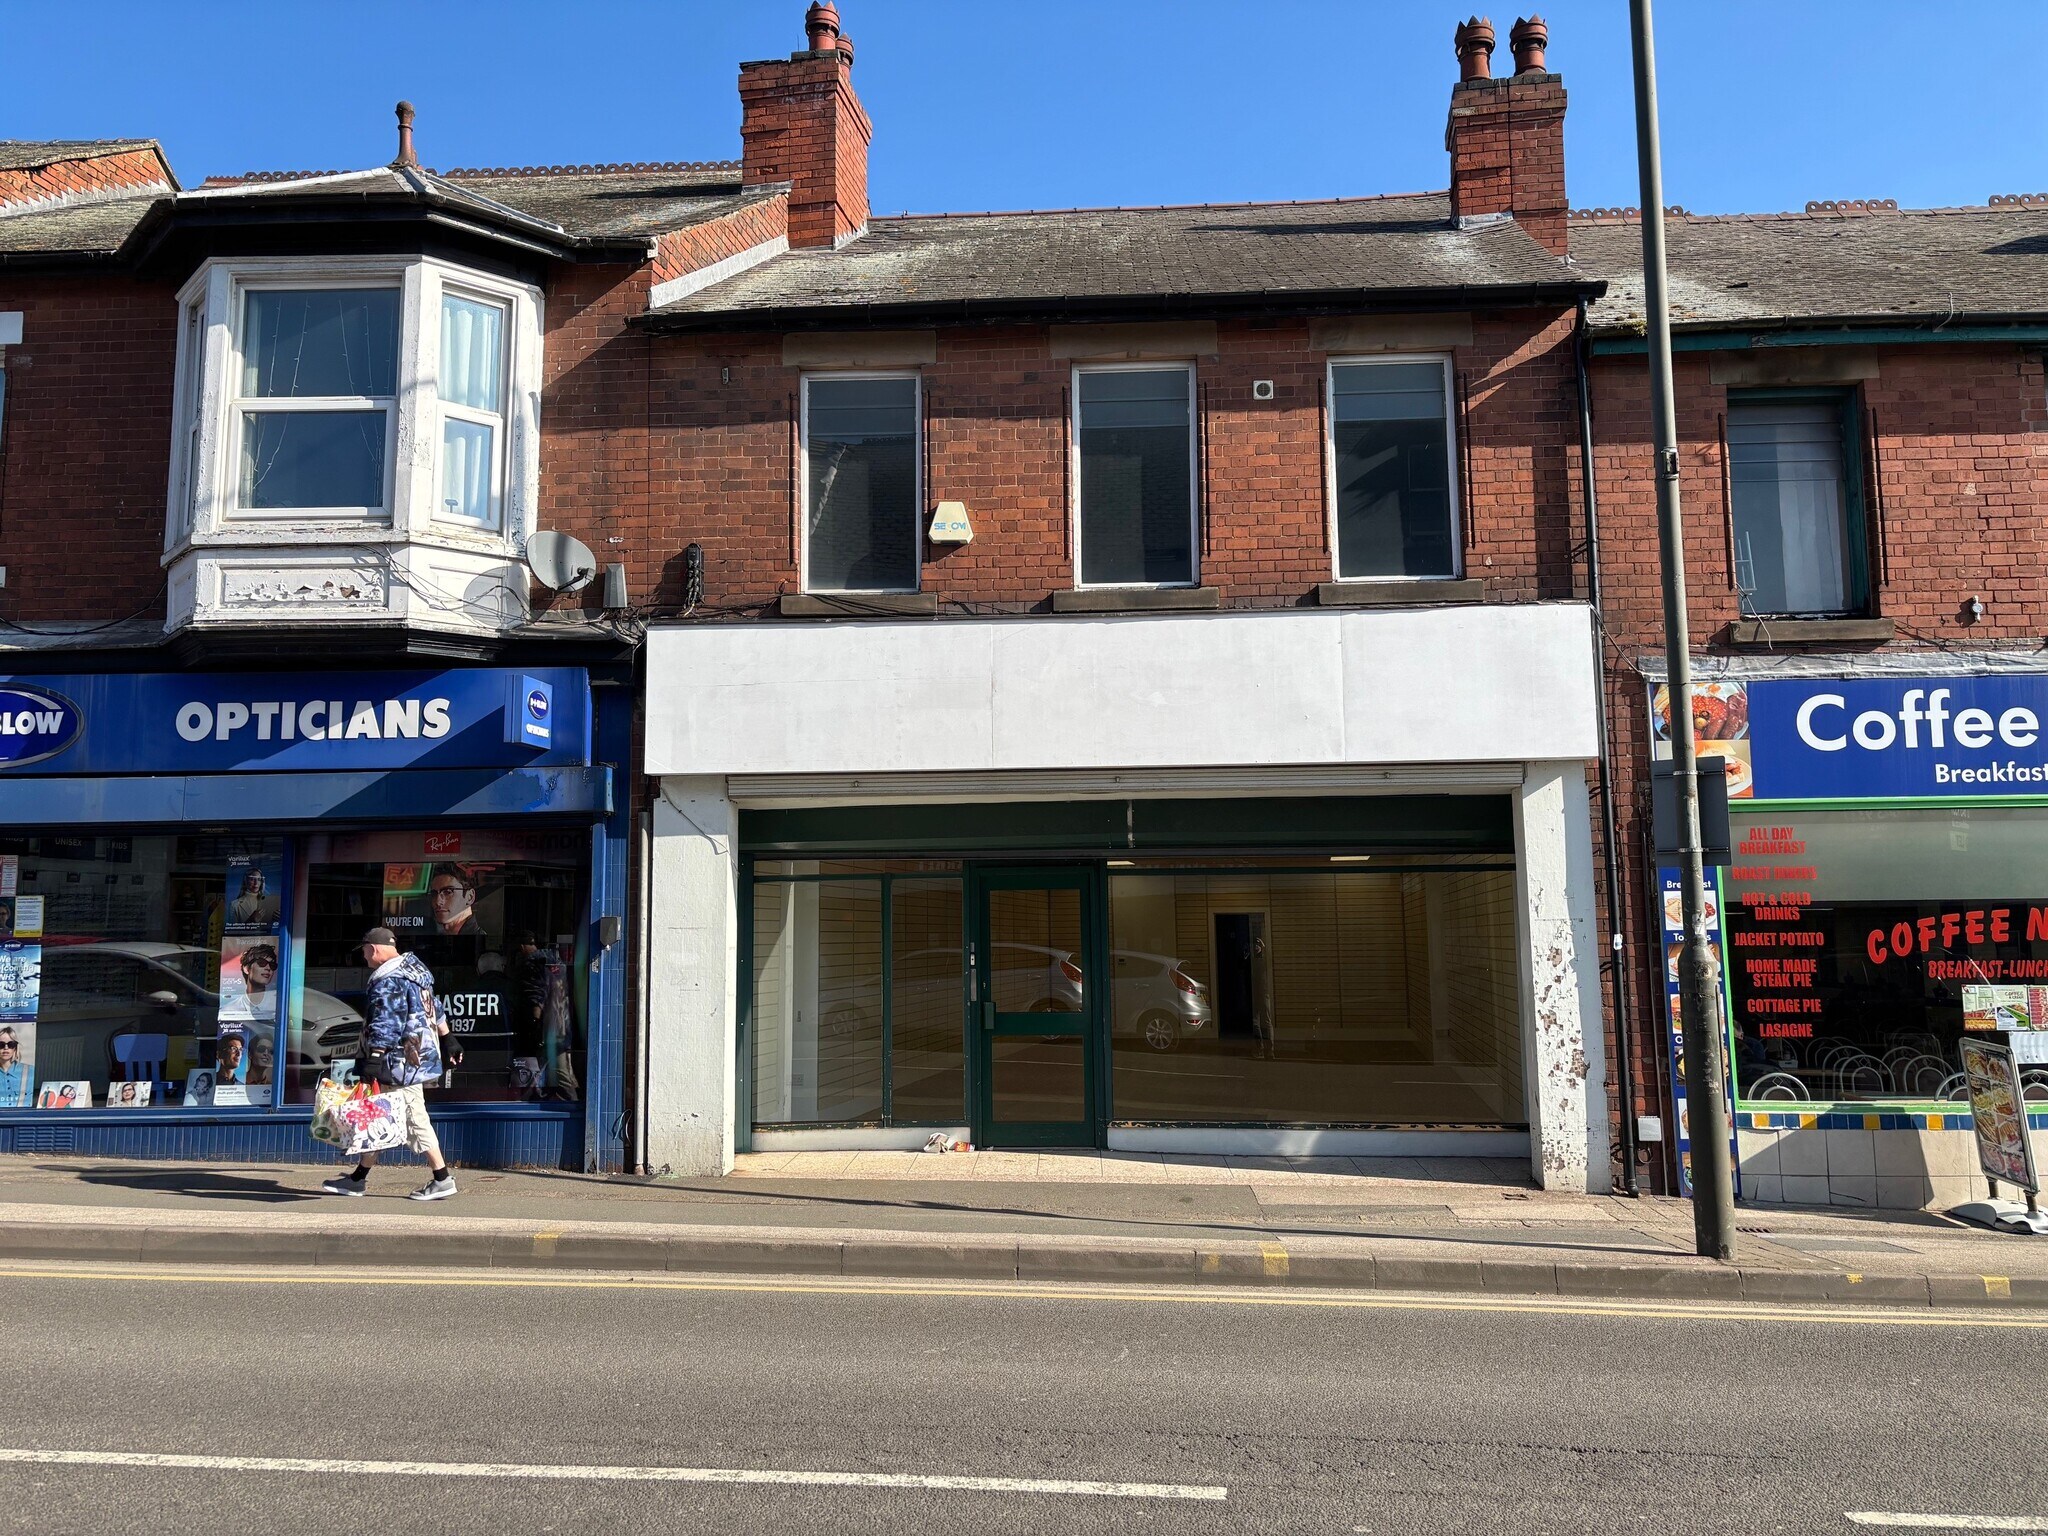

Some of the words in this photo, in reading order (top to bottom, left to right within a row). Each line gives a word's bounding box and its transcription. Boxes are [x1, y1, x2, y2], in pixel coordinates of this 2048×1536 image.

[933, 521, 967, 531] SEOM
[0, 710, 65, 736] LOW
[174, 698, 451, 742] OPTICIANS
[1795, 687, 2040, 752] Coffee
[1934, 760, 2048, 783] Breakfast
[1749, 827, 1769, 840] ALL
[1772, 826, 1794, 840] DAY
[54, 836, 83, 847] UNISEX
[426, 832, 460, 851] Ray-Ban
[1739, 840, 1807, 855] BREAKFAST
[1732, 867, 1770, 880] ROAST
[1666, 880, 1711, 889] Brest
[1742, 892, 1766, 906] HOT
[1768, 893, 1778, 906] &
[1780, 891, 1812, 906] COLD
[1754, 906, 1801, 921] DRINKS
[385, 916, 412, 927] YOU'RE
[412, 916, 424, 927] ON
[1734, 932, 1777, 946] JACKET
[1779, 932, 1825, 946] POTATO
[1867, 908, 2010, 965] COFFEE
[1745, 959, 1780, 973] HOME
[1782, 959, 1818, 973] MADE
[1752, 973, 1791, 988] STEAK
[1793, 973, 1812, 987] PIE
[437, 993, 500, 1017] ASTER
[1747, 999, 1800, 1013] COTTAGE
[1802, 998, 1822, 1013] PIE
[450, 1018, 476, 1032] 1937
[1759, 1023, 1813, 1038] LASAGNE
